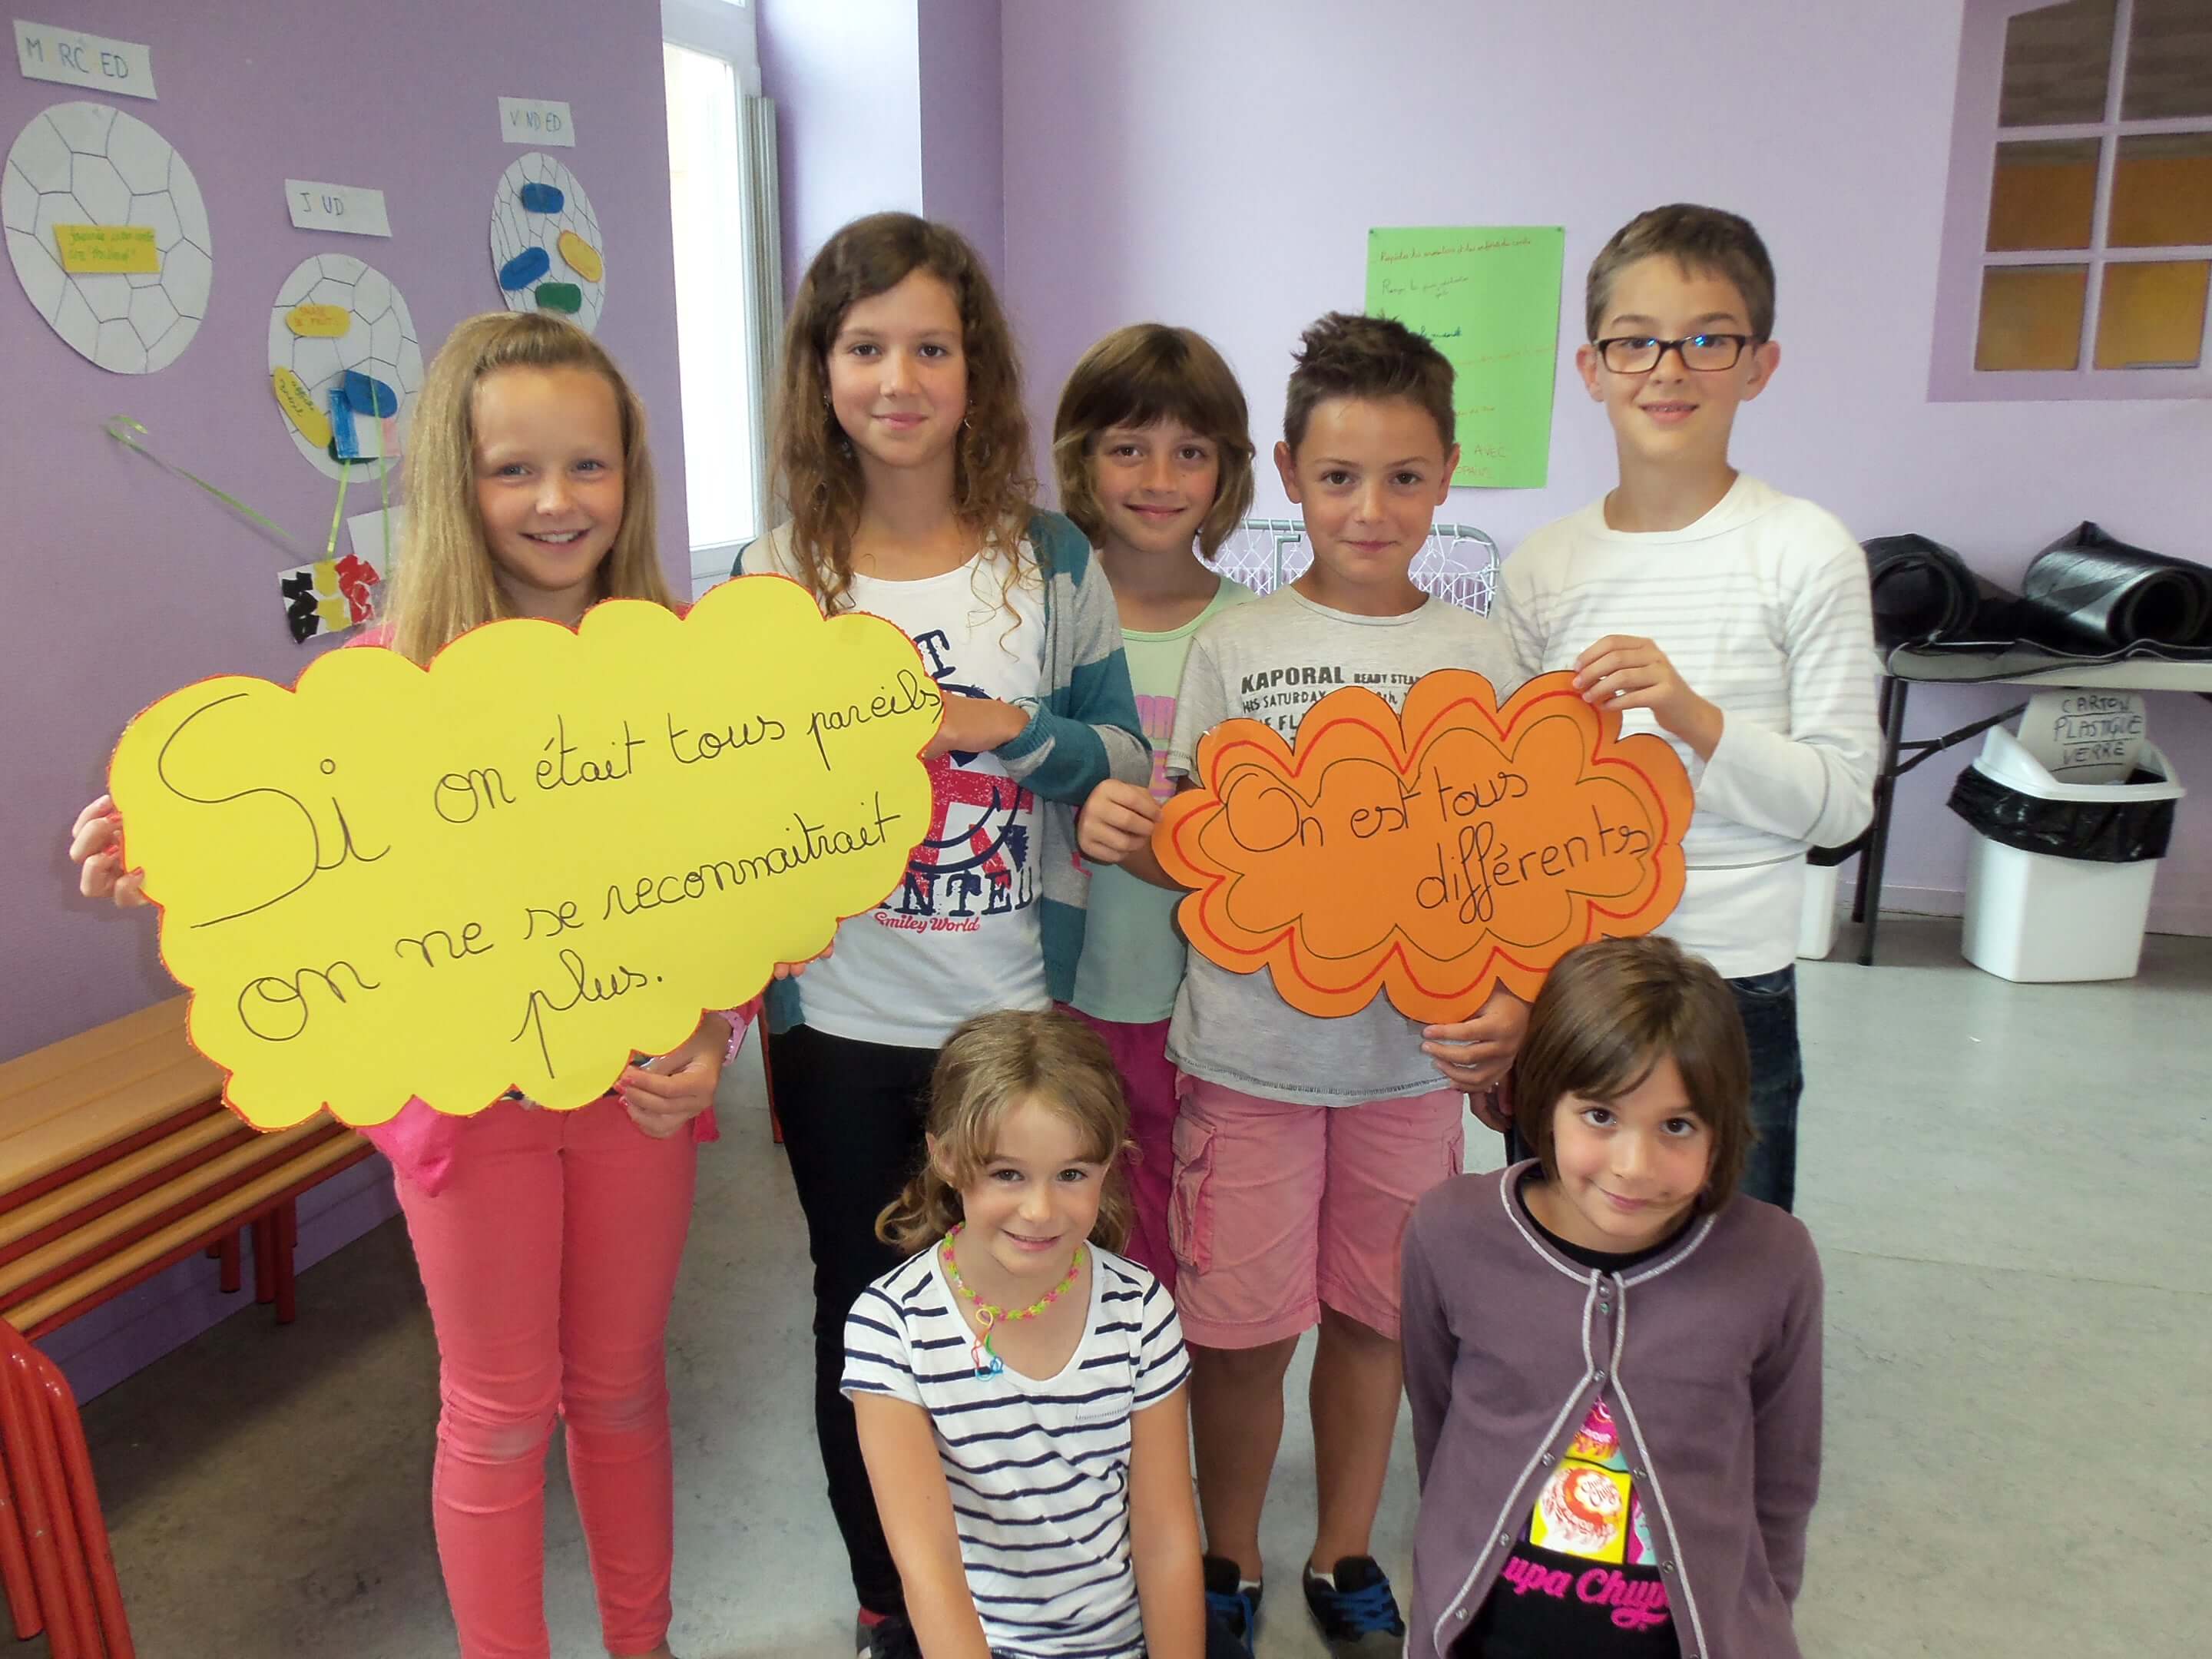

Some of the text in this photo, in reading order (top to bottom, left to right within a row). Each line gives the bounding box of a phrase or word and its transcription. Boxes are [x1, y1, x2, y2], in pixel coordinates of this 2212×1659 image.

[1241, 666, 1345, 695] KAPORAL
[1354, 673, 1388, 684] READY
[1263, 690, 1326, 709] SATURDAY
[2062, 694, 2131, 713] CARTON
[2054, 715, 2144, 742] PLASTIQUE
[2063, 741, 2126, 765] VERRE
[157, 692, 391, 929] Si
[434, 767, 517, 823] on
[536, 713, 646, 790] était
[667, 712, 786, 763] tous
[1225, 766, 1528, 853] On est tous
[874, 911, 981, 935] Smiley World
[237, 960, 381, 1041] on
[395, 921, 495, 968] ne
[522, 899, 586, 941] se
[510, 948, 664, 1080] plus.
